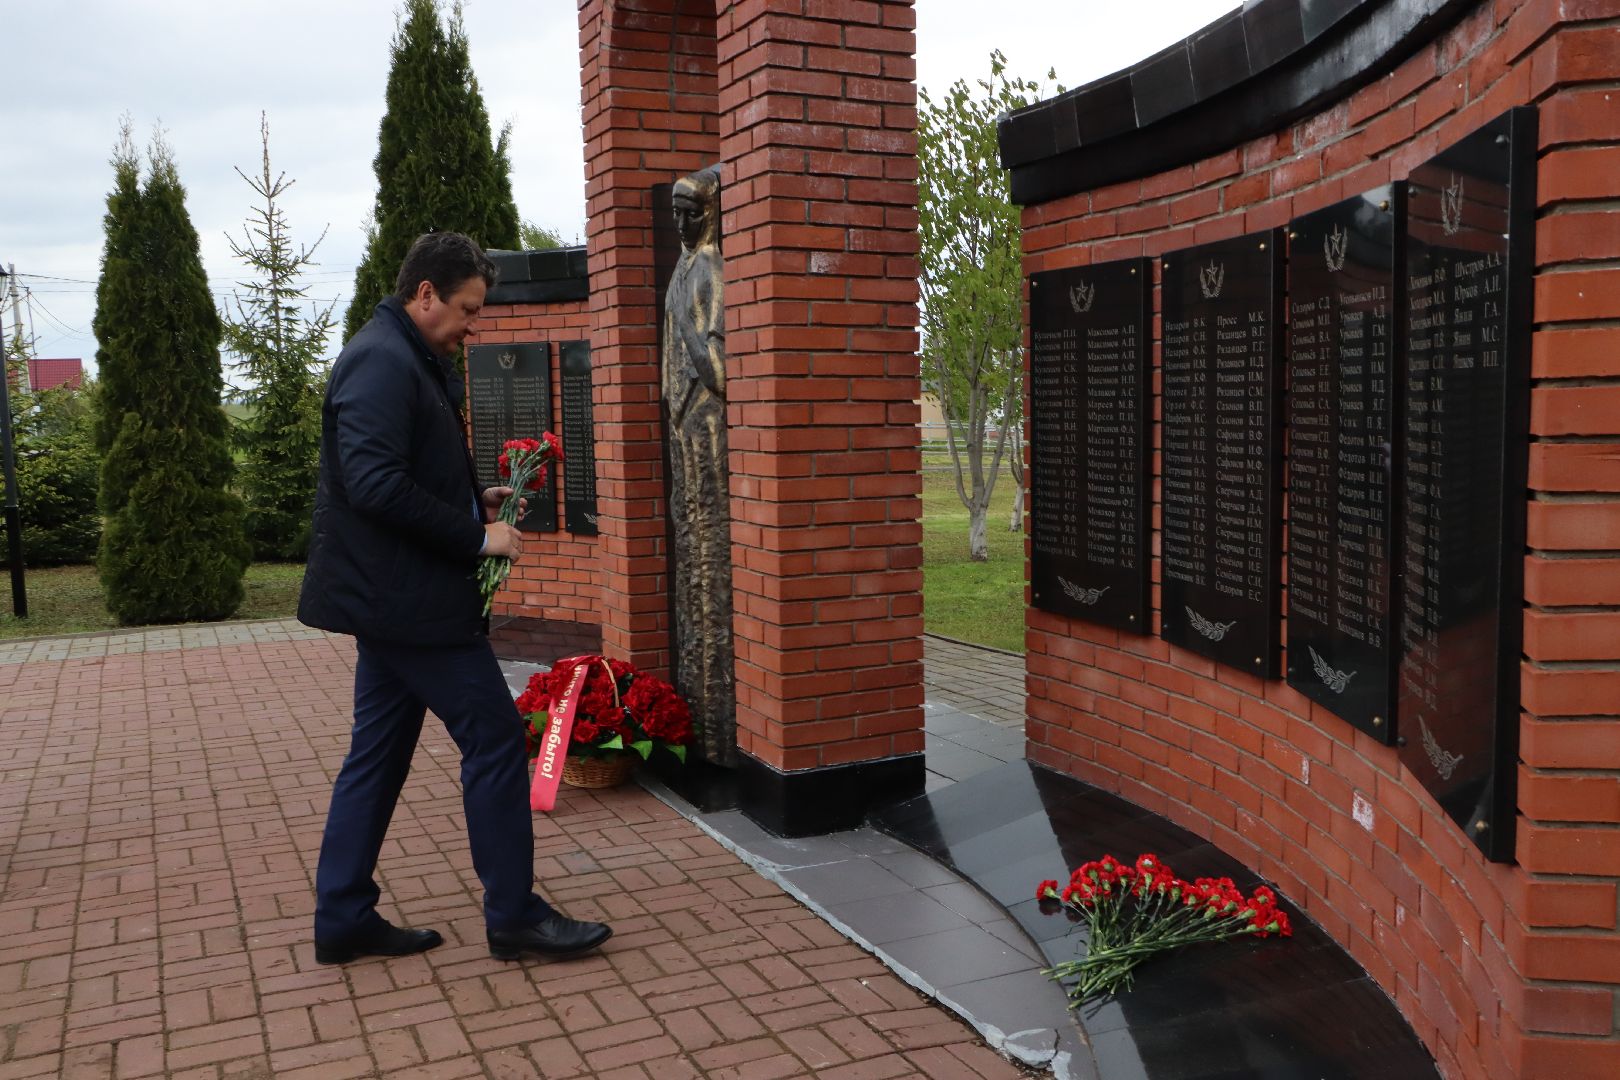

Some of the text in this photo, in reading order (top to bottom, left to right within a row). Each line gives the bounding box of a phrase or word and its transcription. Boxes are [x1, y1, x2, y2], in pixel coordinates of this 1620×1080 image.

[1088, 325, 1136, 337] Максимов А.П.
[1088, 338, 1136, 349] Максимов А.П.
[1088, 351, 1136, 361] Максимов А.П.
[1088, 365, 1118, 373] Максимов
[1118, 400, 1136, 409] М.В.
[1216, 415, 1243, 425] Сазонов
[1088, 435, 1114, 444] Маслов
[1088, 447, 1114, 456] Маслов
[555, 700, 568, 713] не
[541, 717, 563, 779] забыто!
